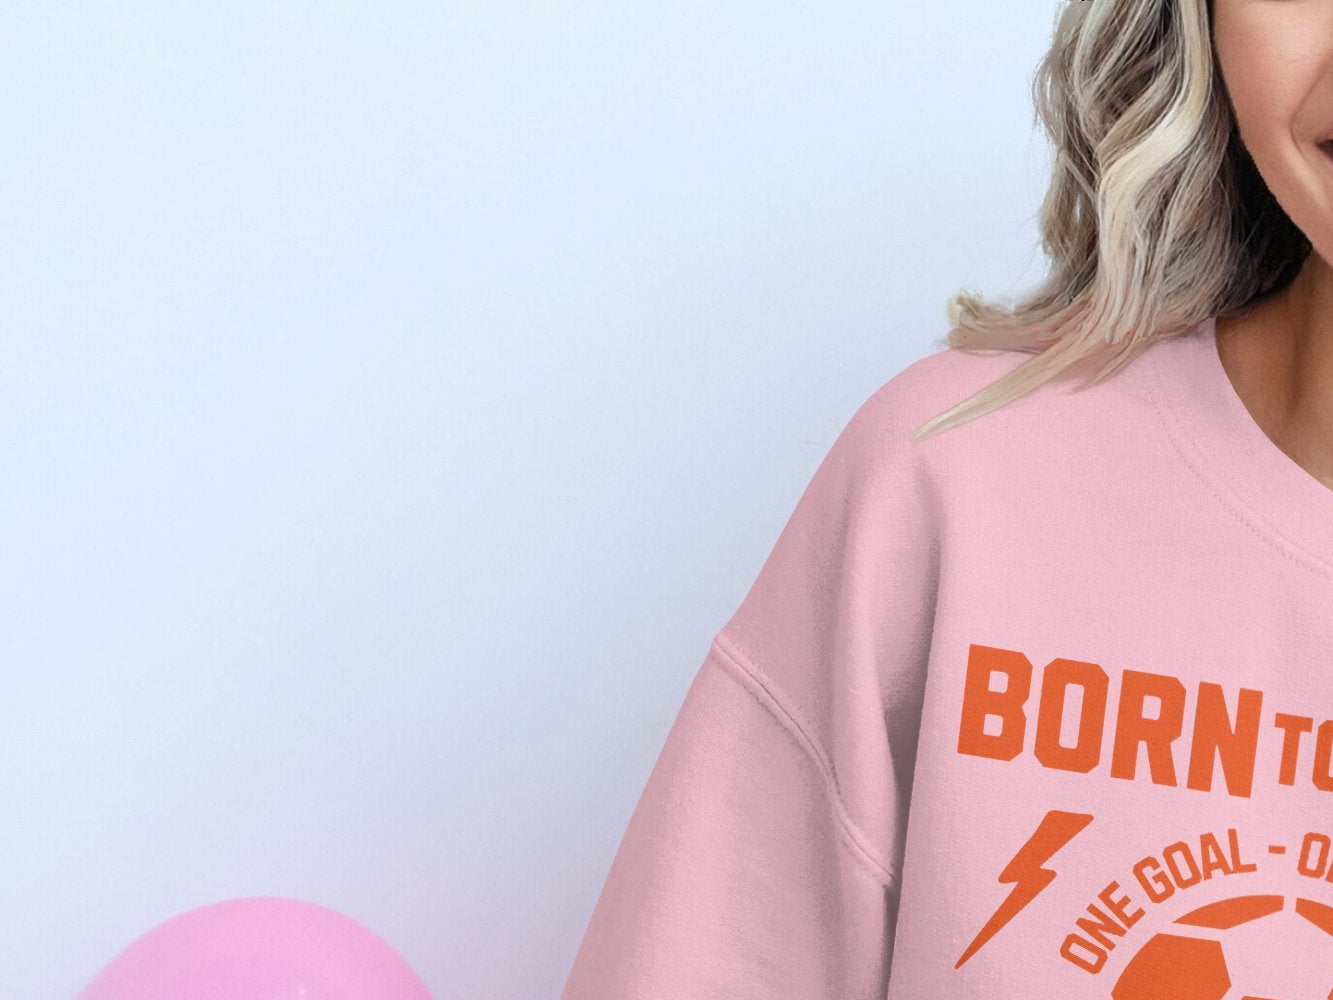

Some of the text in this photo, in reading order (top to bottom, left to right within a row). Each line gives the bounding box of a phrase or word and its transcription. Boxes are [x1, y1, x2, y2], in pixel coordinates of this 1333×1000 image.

[956, 643, 1264, 799] BORN
[1060, 881, 1145, 975] ONE
[1134, 828, 1257, 904] GOAL
